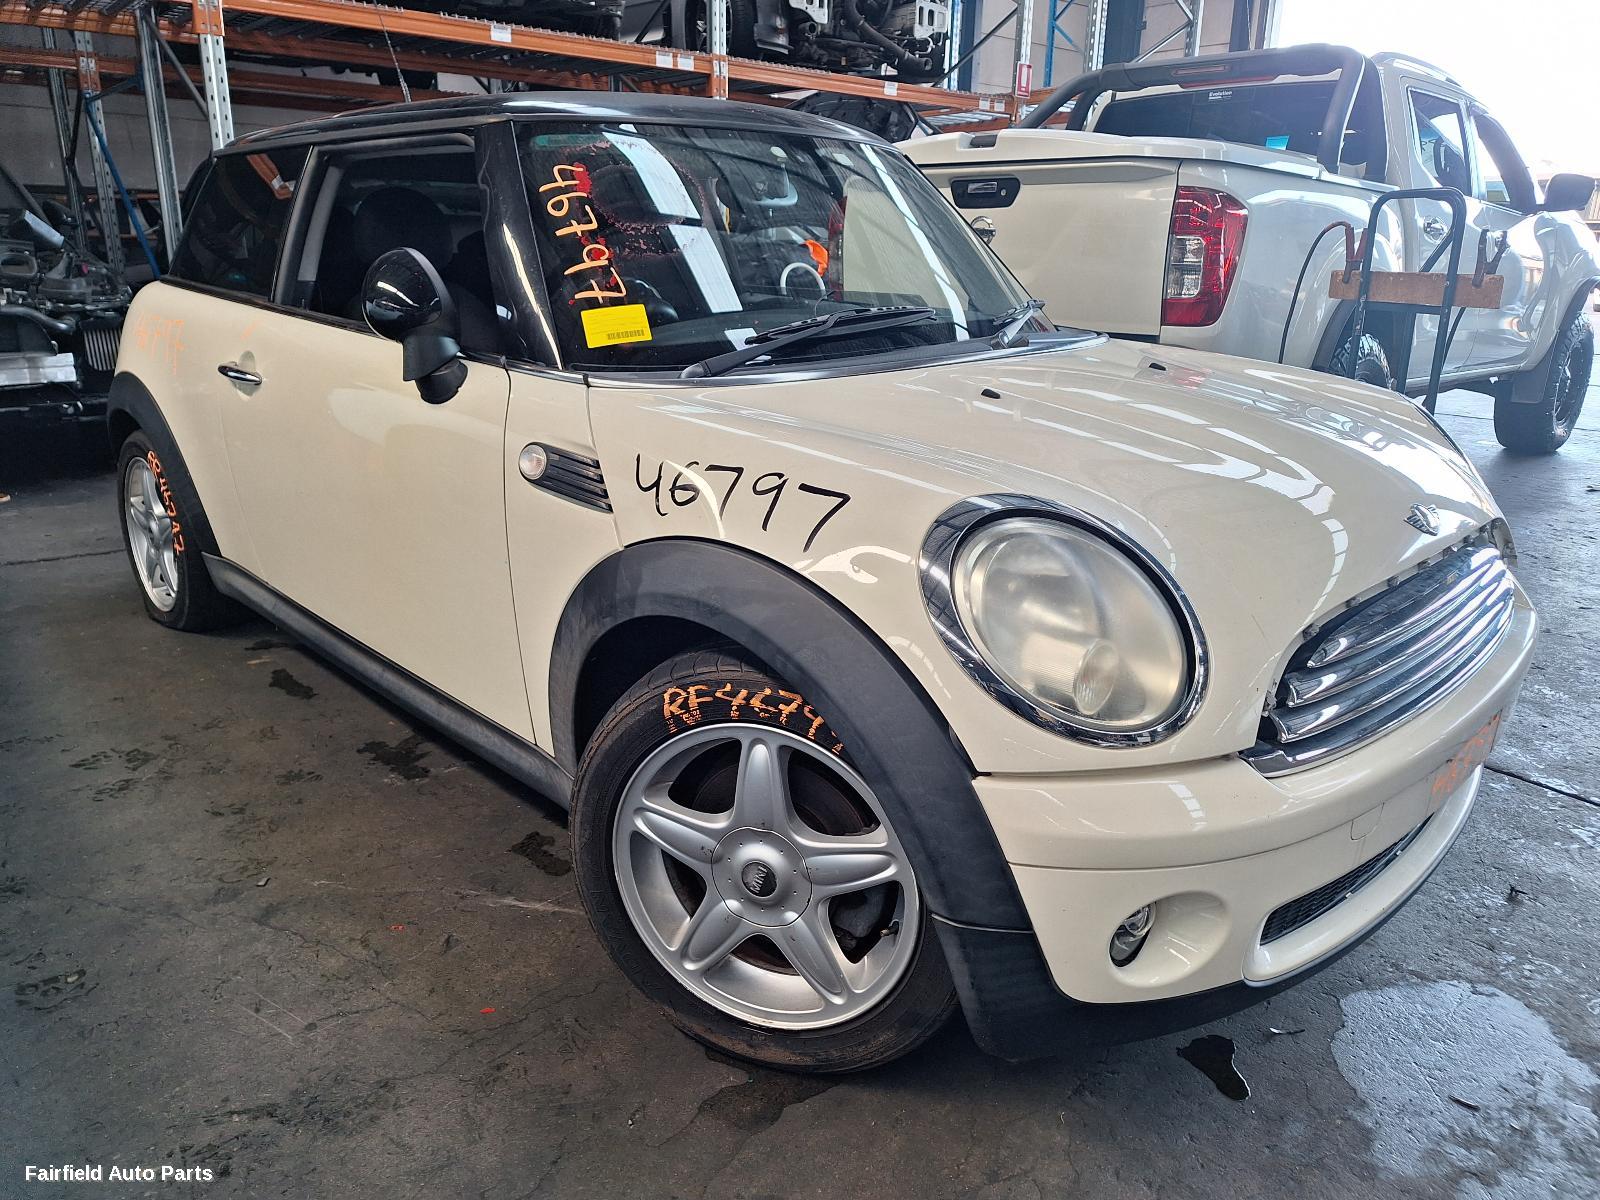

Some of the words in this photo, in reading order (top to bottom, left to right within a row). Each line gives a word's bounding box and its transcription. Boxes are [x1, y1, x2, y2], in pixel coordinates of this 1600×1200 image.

[539, 164, 627, 304] 46797
[635, 453, 852, 553] 46797
[750, 865, 768, 894] MINI
